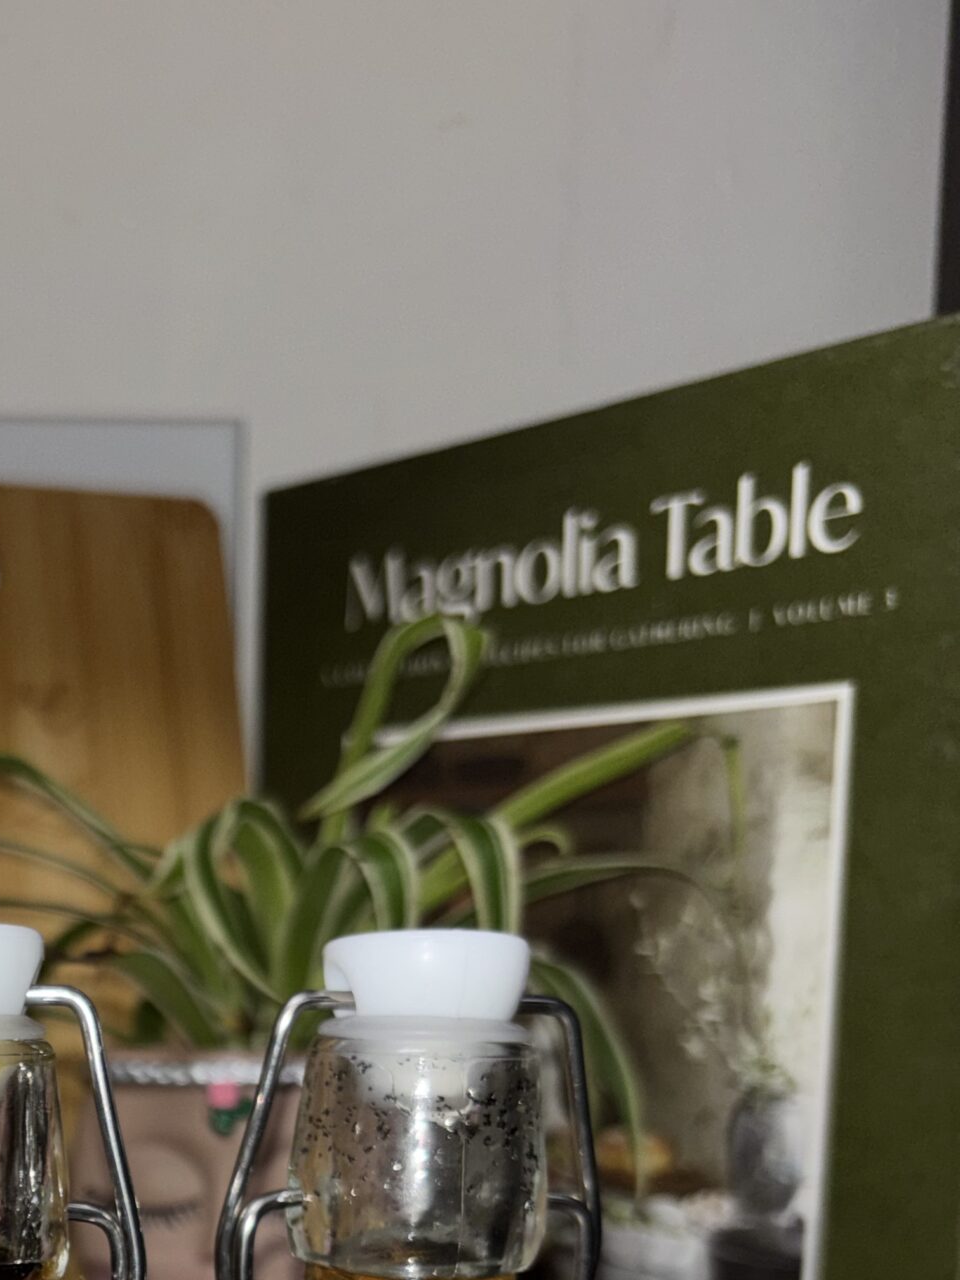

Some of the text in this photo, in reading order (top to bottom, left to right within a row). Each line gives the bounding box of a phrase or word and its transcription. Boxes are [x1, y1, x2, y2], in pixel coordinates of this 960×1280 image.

[343, 460, 864, 632] Magnolia Table
[773, 590, 872, 626] VOLUME
